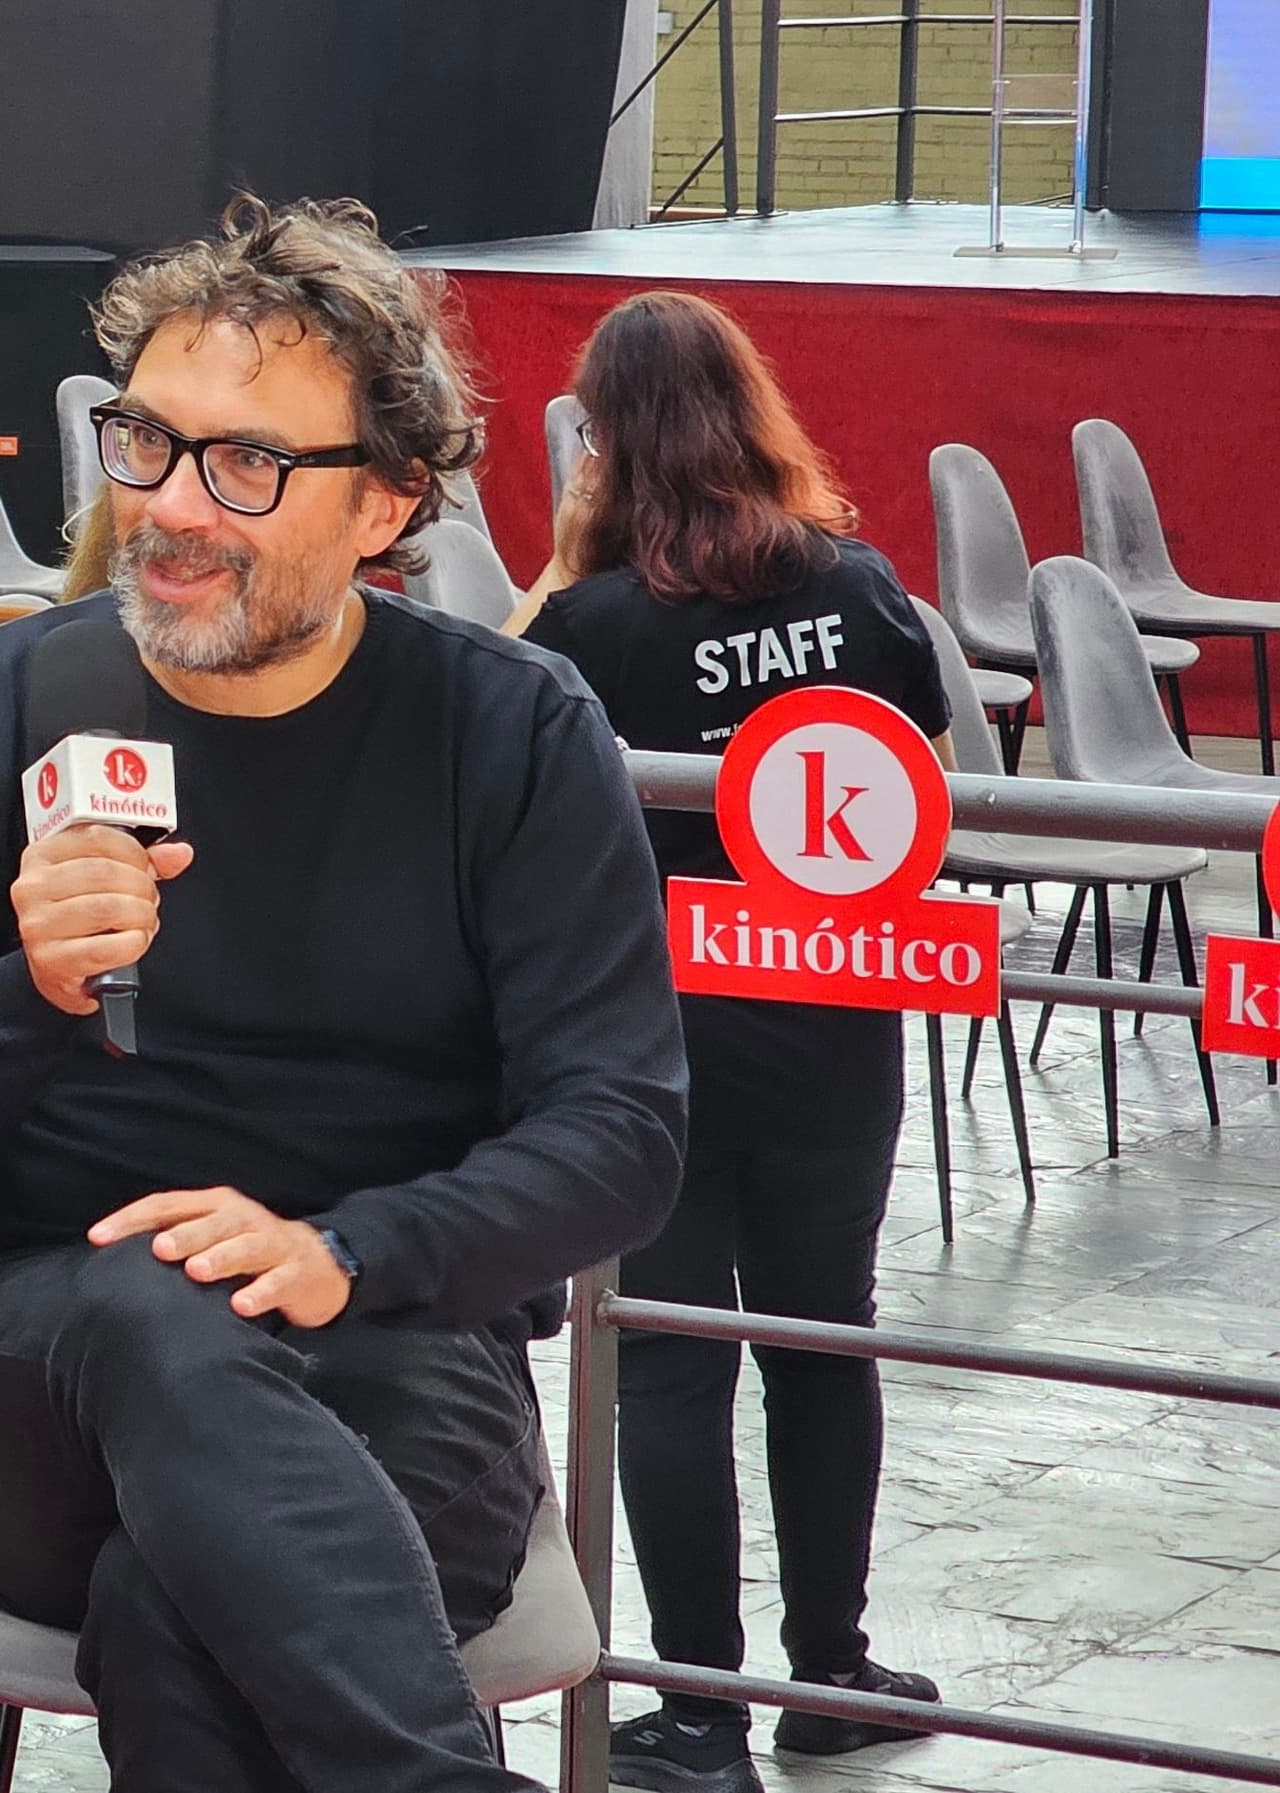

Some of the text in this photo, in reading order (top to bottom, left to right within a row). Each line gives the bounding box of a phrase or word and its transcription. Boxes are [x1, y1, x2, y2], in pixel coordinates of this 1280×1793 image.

[694, 614, 844, 694] STAFF
[89, 792, 168, 818] kinótico
[795, 751, 874, 862] k
[687, 904, 983, 987] kinótico
